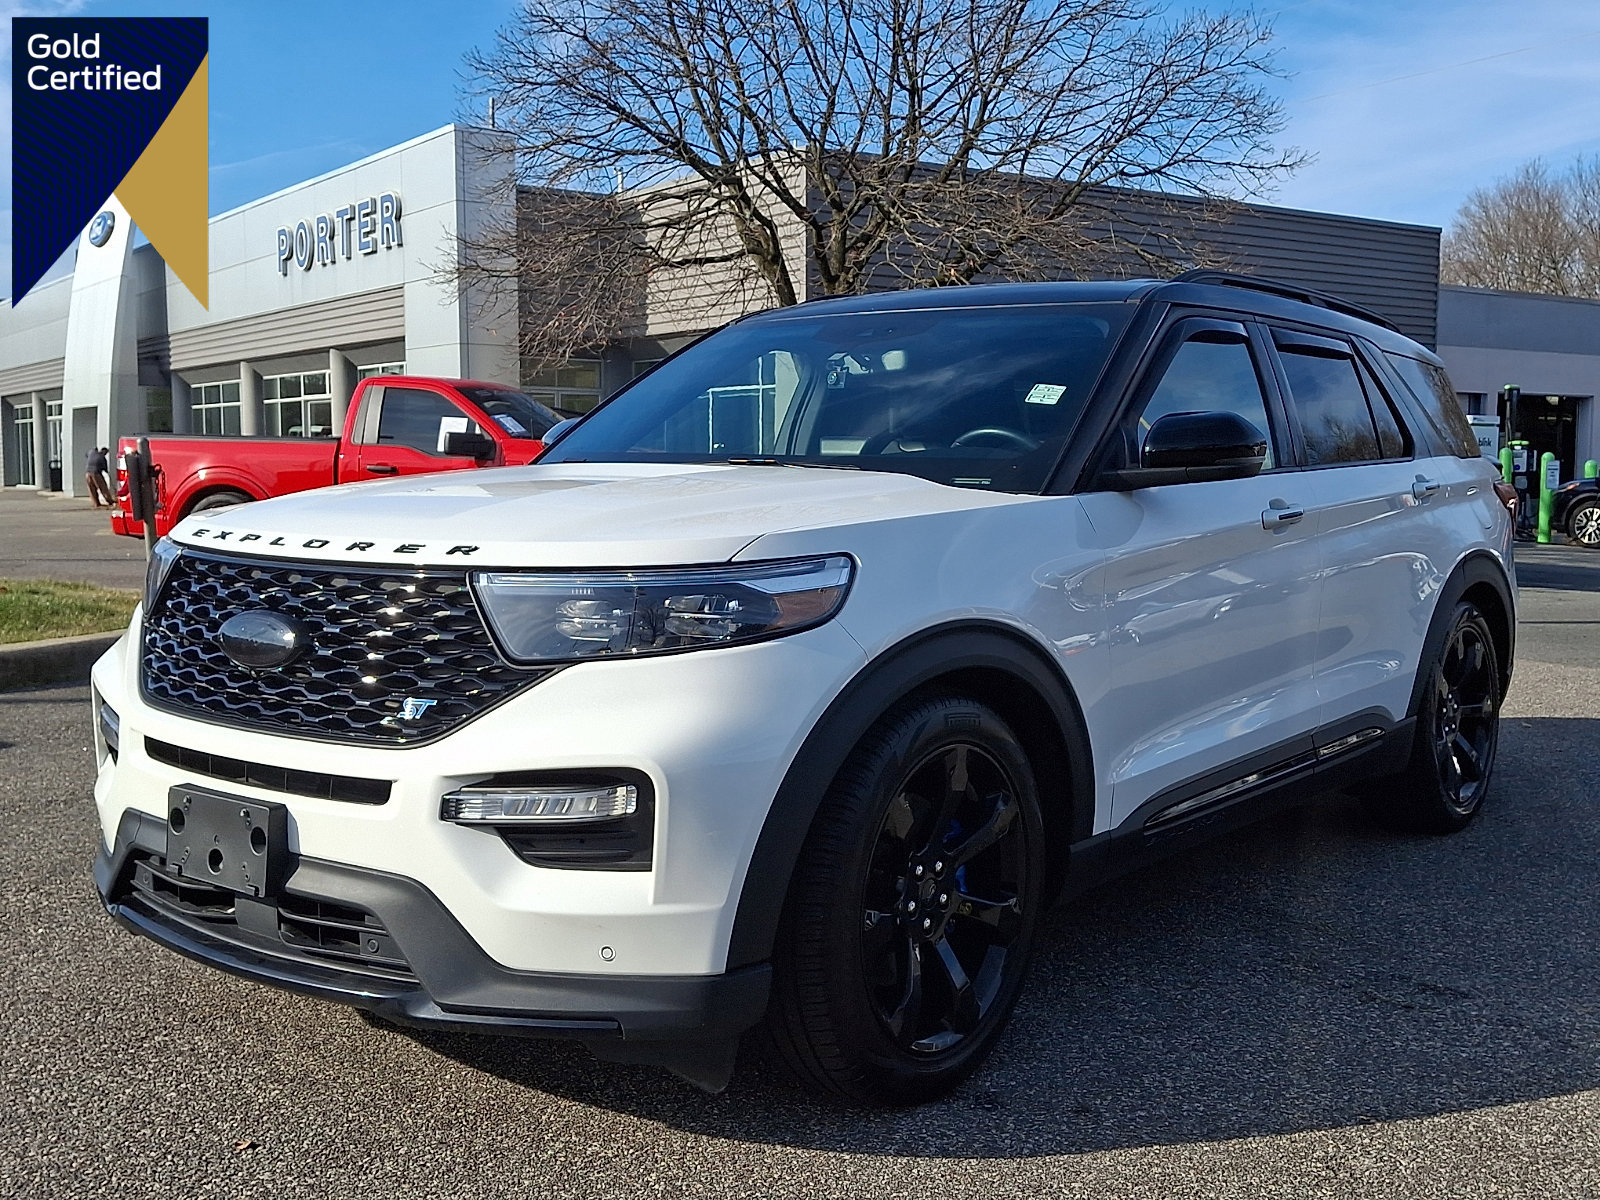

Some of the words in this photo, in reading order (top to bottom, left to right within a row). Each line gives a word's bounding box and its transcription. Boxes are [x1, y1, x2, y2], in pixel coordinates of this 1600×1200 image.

[276, 190, 403, 277] PORTER
[191, 528, 480, 556] EXPLORER
[397, 697, 438, 720] ST
